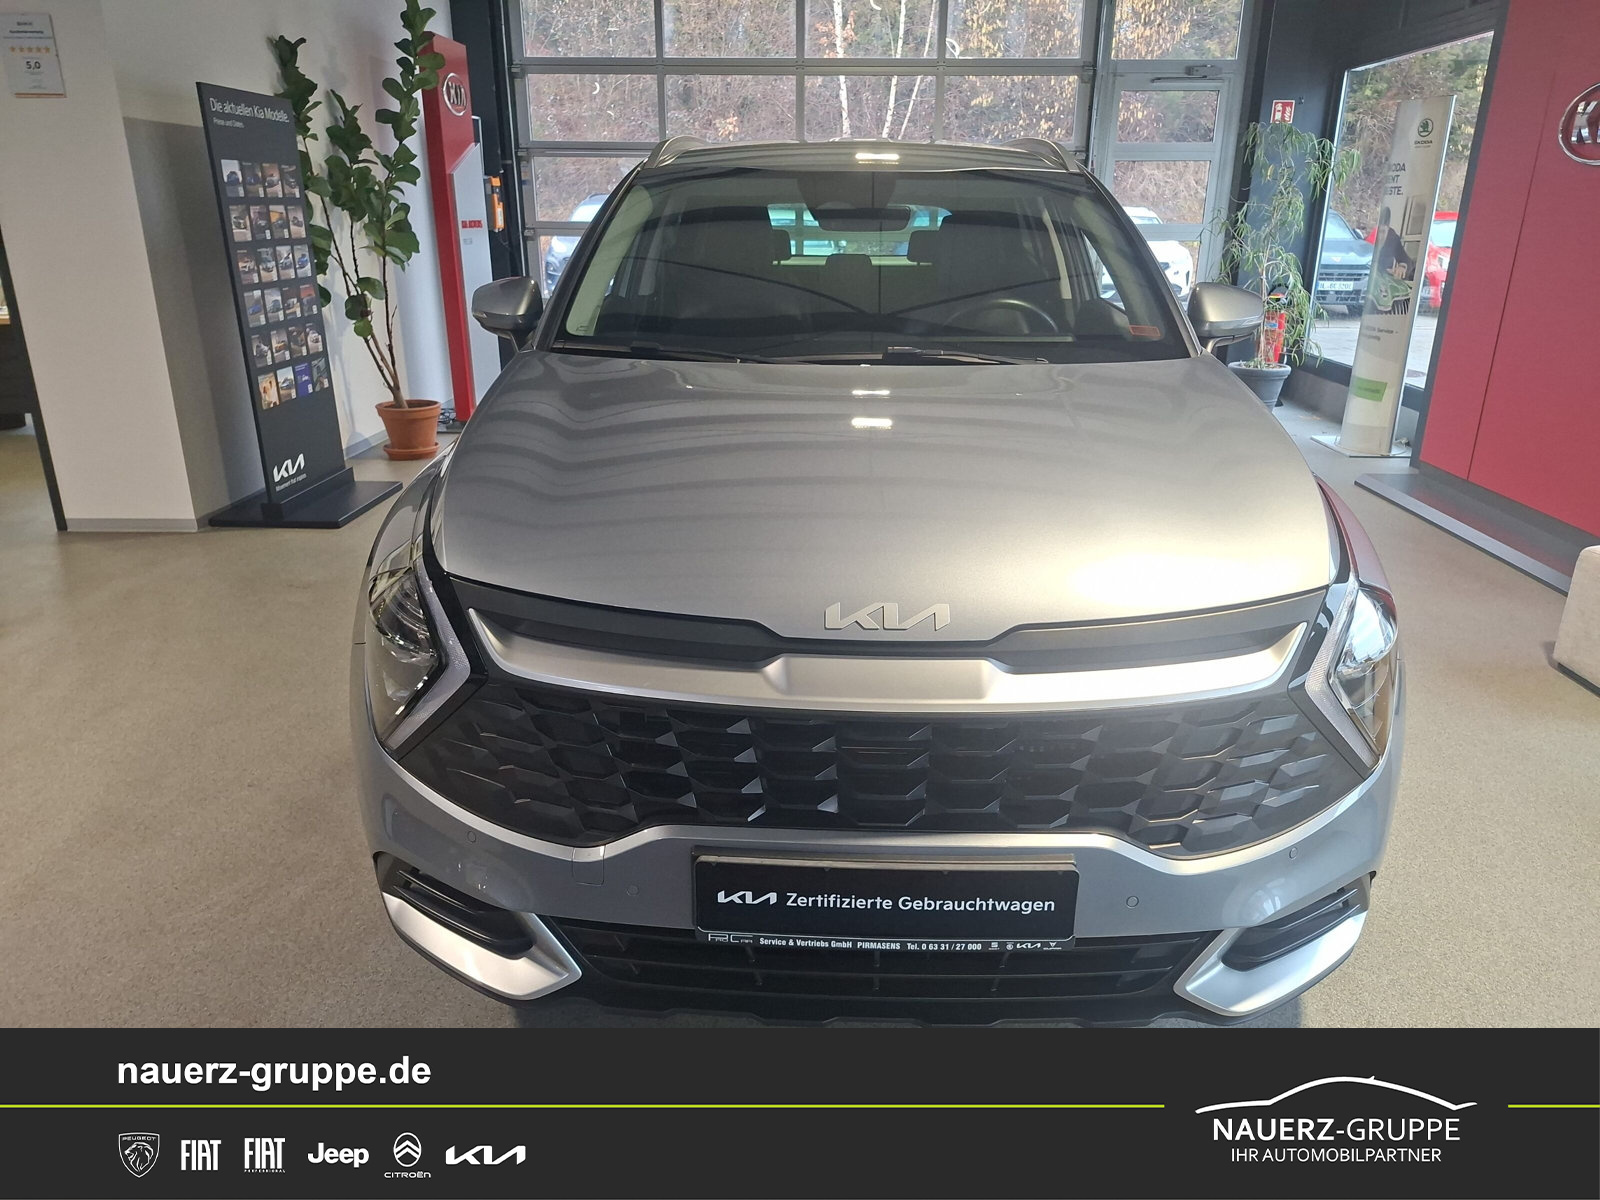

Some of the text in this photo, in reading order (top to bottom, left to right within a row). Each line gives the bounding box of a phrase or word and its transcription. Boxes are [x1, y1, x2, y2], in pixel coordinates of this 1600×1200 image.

[26, 61, 41, 70] 5,0
[448, 81, 467, 107] KIA
[209, 97, 223, 113] Die
[223, 101, 253, 117] aktuellen
[253, 105, 264, 119] Kia
[273, 453, 305, 482] KIA
[824, 601, 951, 631] KIA
[717, 890, 1055, 915] KIA Zertifizierte Gebrauchtwagen
[759, 937, 785, 946] Service
[796, 938, 829, 948] Vertriebs
[831, 940, 852, 948] GmbH
[857, 941, 901, 950] PIRMASENS
[907, 942, 920, 950] Tel.
[955, 943, 965, 951] 27
[967, 943, 982, 951] 000
